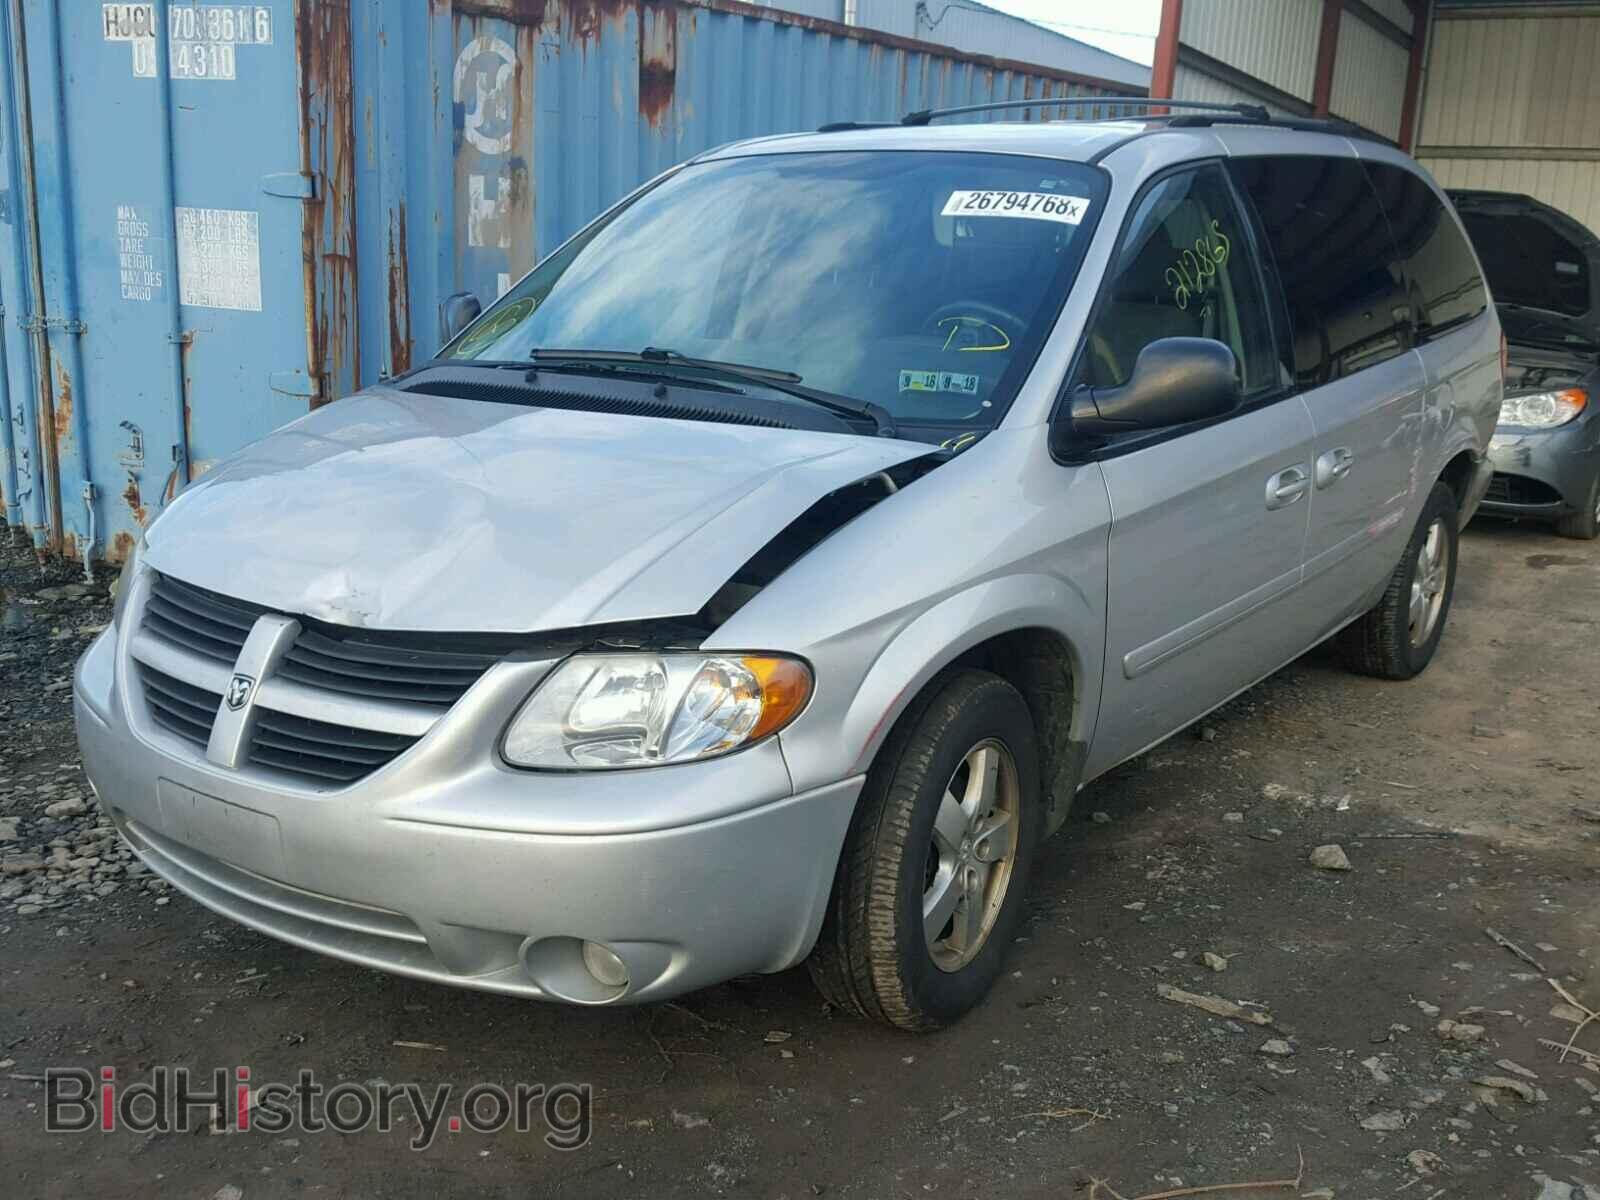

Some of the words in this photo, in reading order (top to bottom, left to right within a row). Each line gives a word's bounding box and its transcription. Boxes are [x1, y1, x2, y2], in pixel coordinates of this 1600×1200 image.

[177, 45, 233, 76] 4310
[117, 206, 137, 220] MAX
[118, 221, 149, 237] GROSS
[119, 237, 144, 253] TARE
[120, 253, 153, 271] WEIGHT
[121, 285, 151, 301] CARGO
